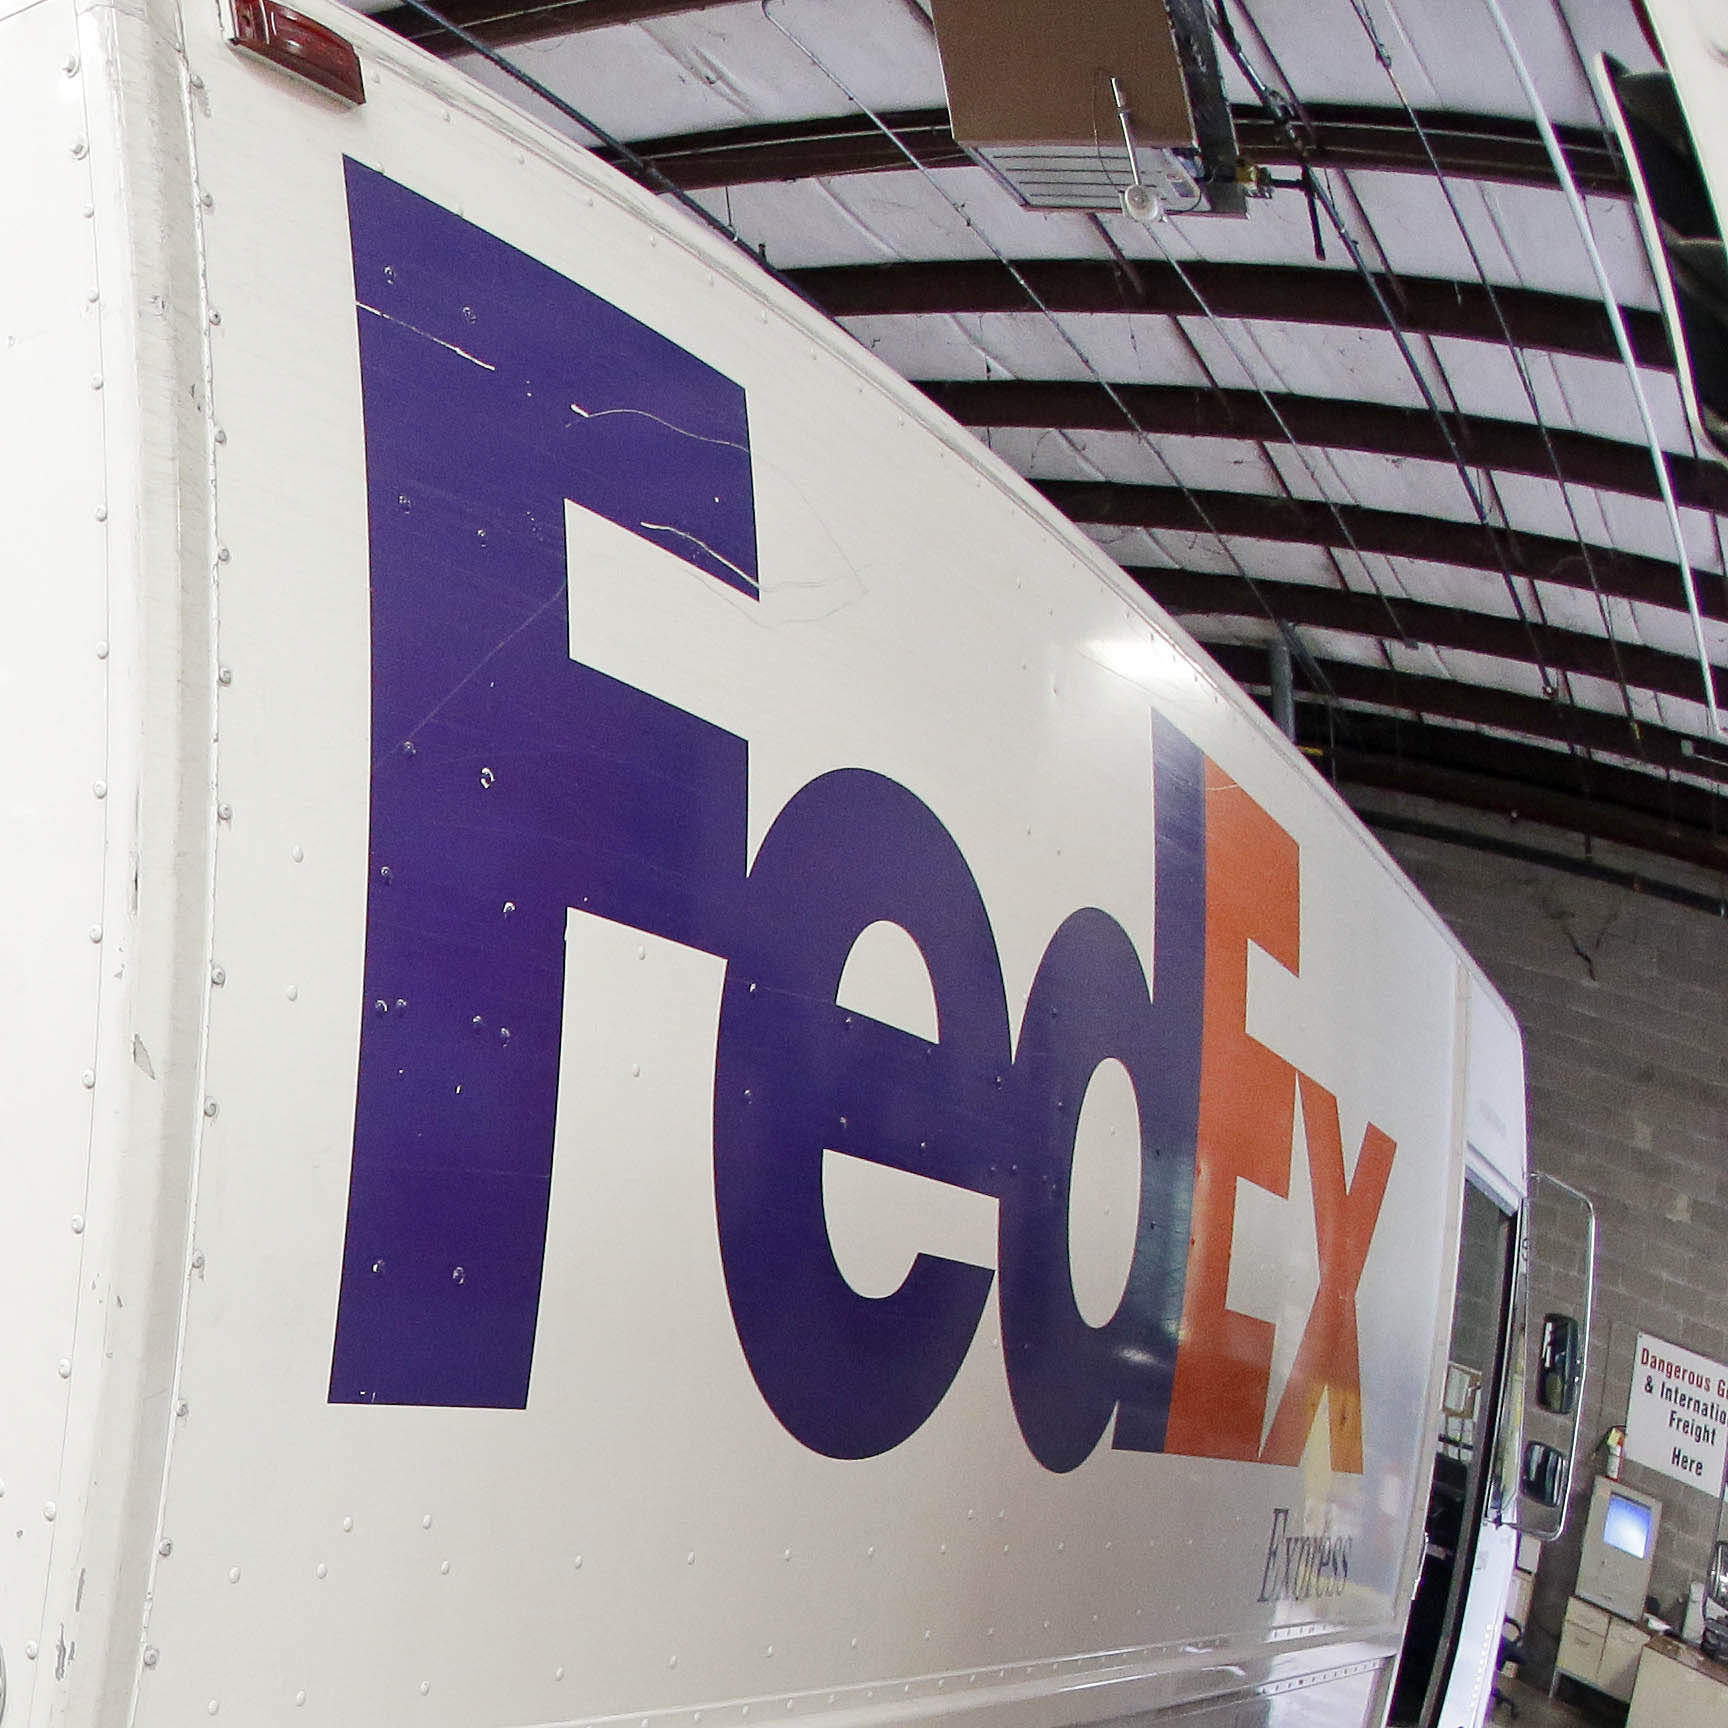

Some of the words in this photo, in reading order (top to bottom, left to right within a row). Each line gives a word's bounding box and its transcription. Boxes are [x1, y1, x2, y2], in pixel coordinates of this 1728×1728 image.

[328, 152, 1396, 1475] FedEx
[1640, 1347, 1712, 1392] Dangerous
[1644, 1375, 1653, 1394] &
[1669, 1410, 1716, 1446] Freight
[1671, 1446, 1704, 1477] Here
[1256, 1507, 1353, 1602] Express
